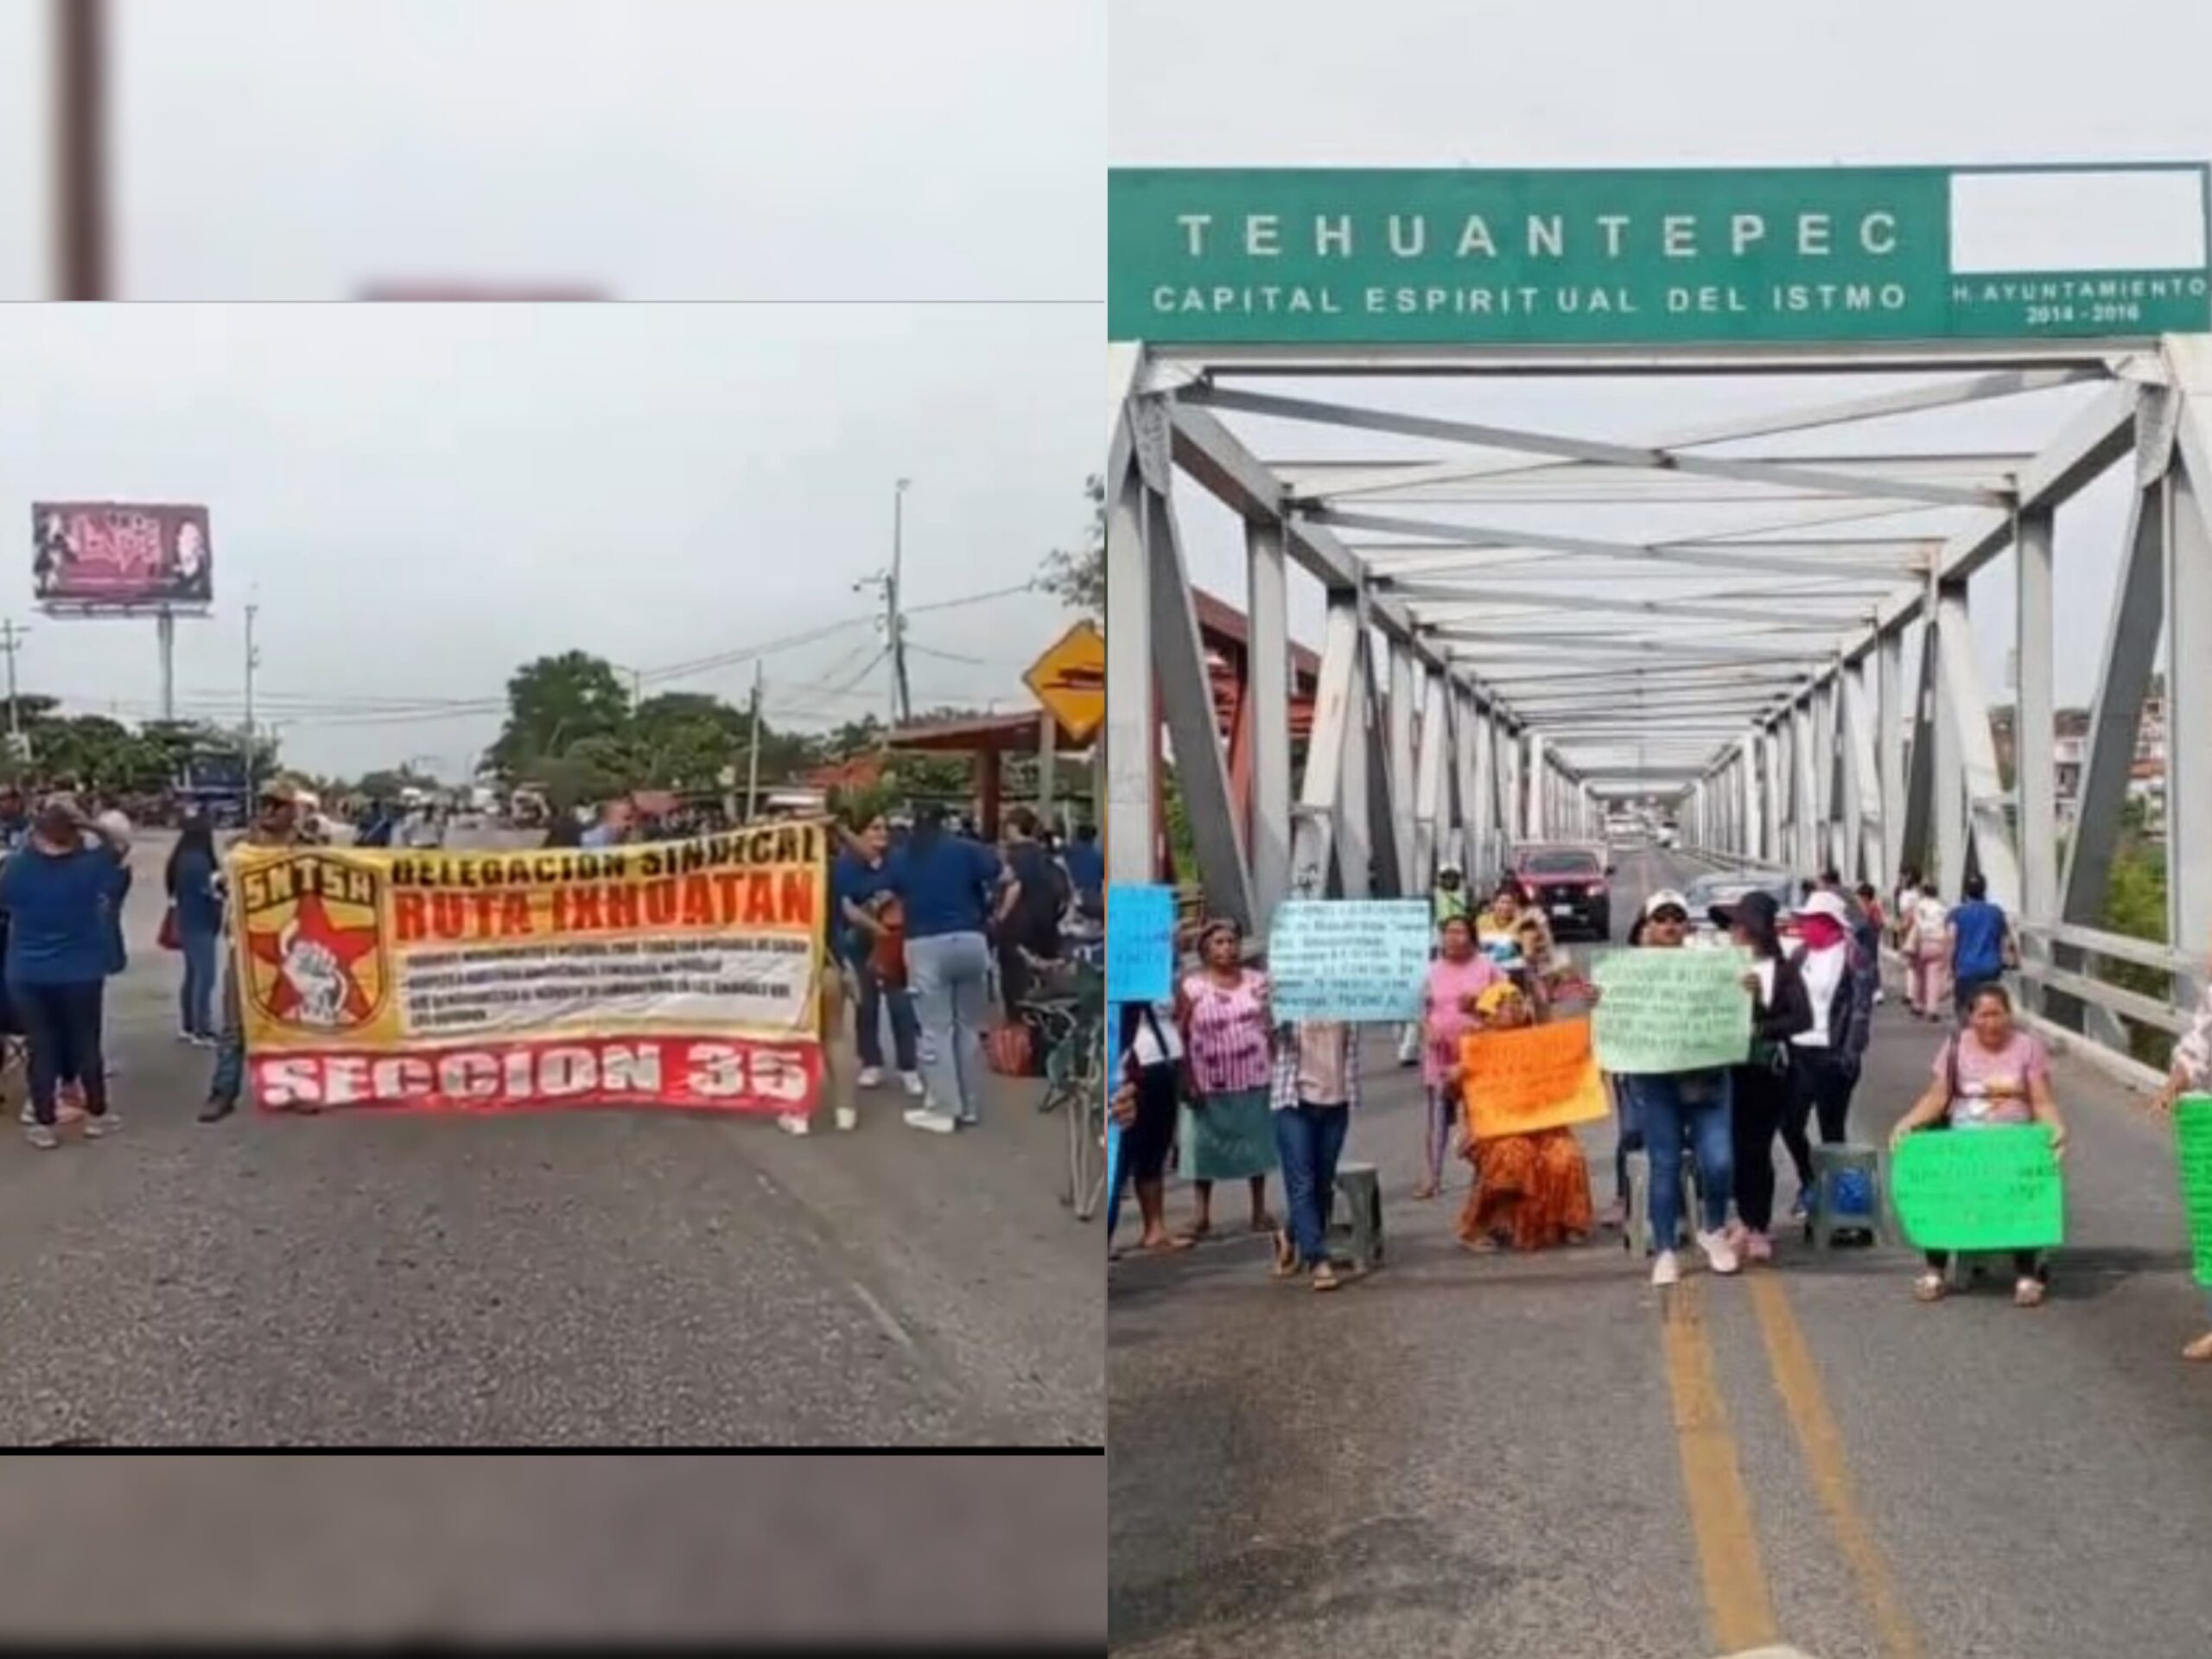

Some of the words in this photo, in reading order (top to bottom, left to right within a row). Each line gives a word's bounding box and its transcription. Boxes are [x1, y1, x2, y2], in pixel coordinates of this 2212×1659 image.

[1178, 213, 1897, 256] TEHUANTEPEC
[1153, 287, 1342, 313] CAPITAL
[1667, 287, 1747, 312] DEL
[1774, 284, 1906, 312] ISTMO
[1984, 276, 2208, 302] AYUNTAMIENTO
[391, 853, 626, 887] DELEGACION
[639, 823, 819, 876] SINDICAL
[393, 889, 533, 942] RUTA
[551, 870, 815, 931] IXHUATAN
[262, 1044, 663, 1106] SECCION
[686, 1042, 808, 1101] 35
